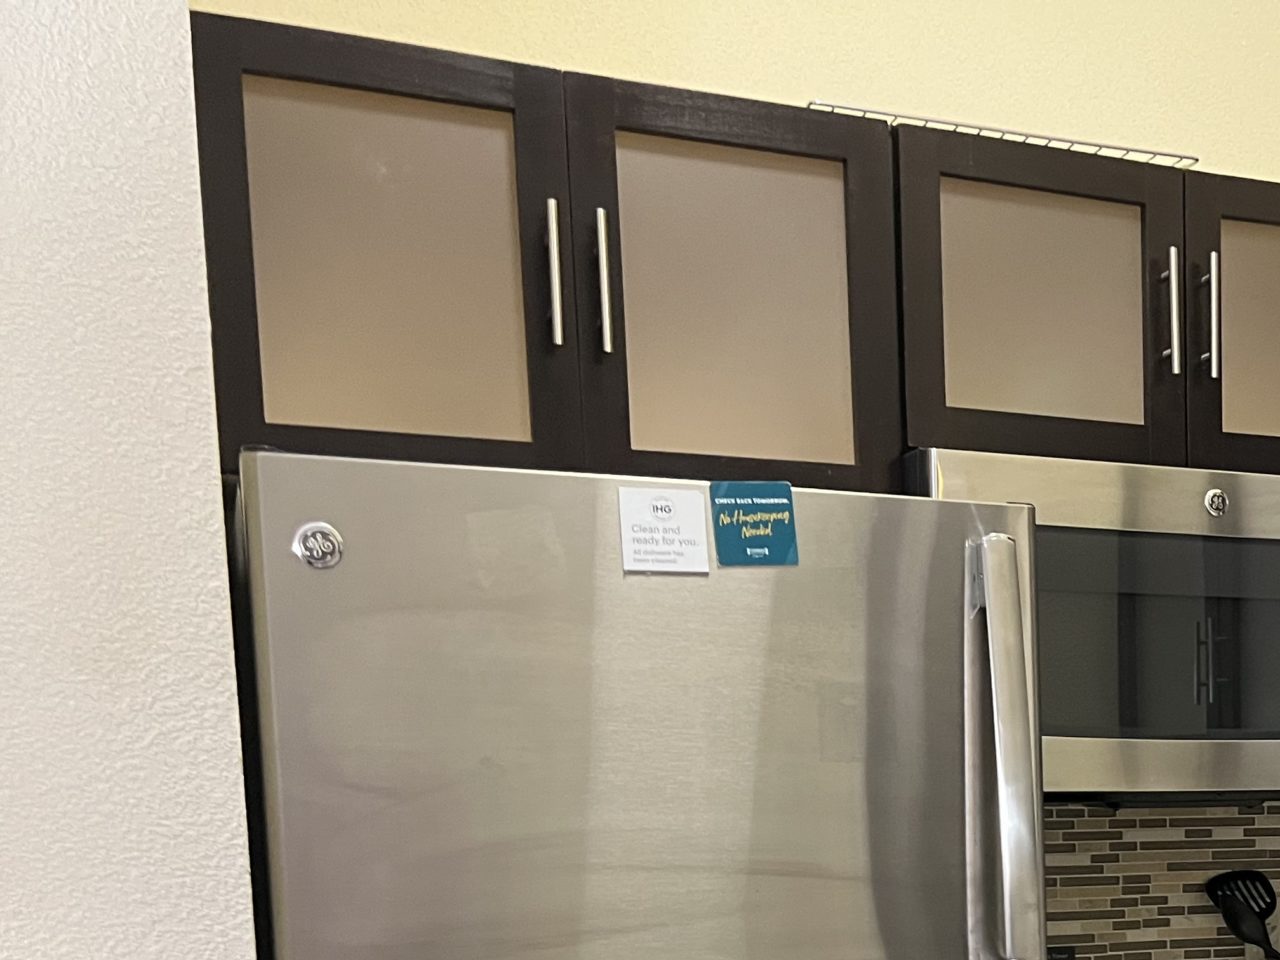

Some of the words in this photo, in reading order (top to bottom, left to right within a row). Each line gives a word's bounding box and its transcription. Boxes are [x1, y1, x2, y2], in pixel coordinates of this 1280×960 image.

[652, 504, 672, 514] IHG
[719, 510, 731, 527] No
[631, 524, 660, 534] Clean
[662, 526, 680, 535] and
[632, 536, 659, 546] ready
[662, 536, 675, 546] for
